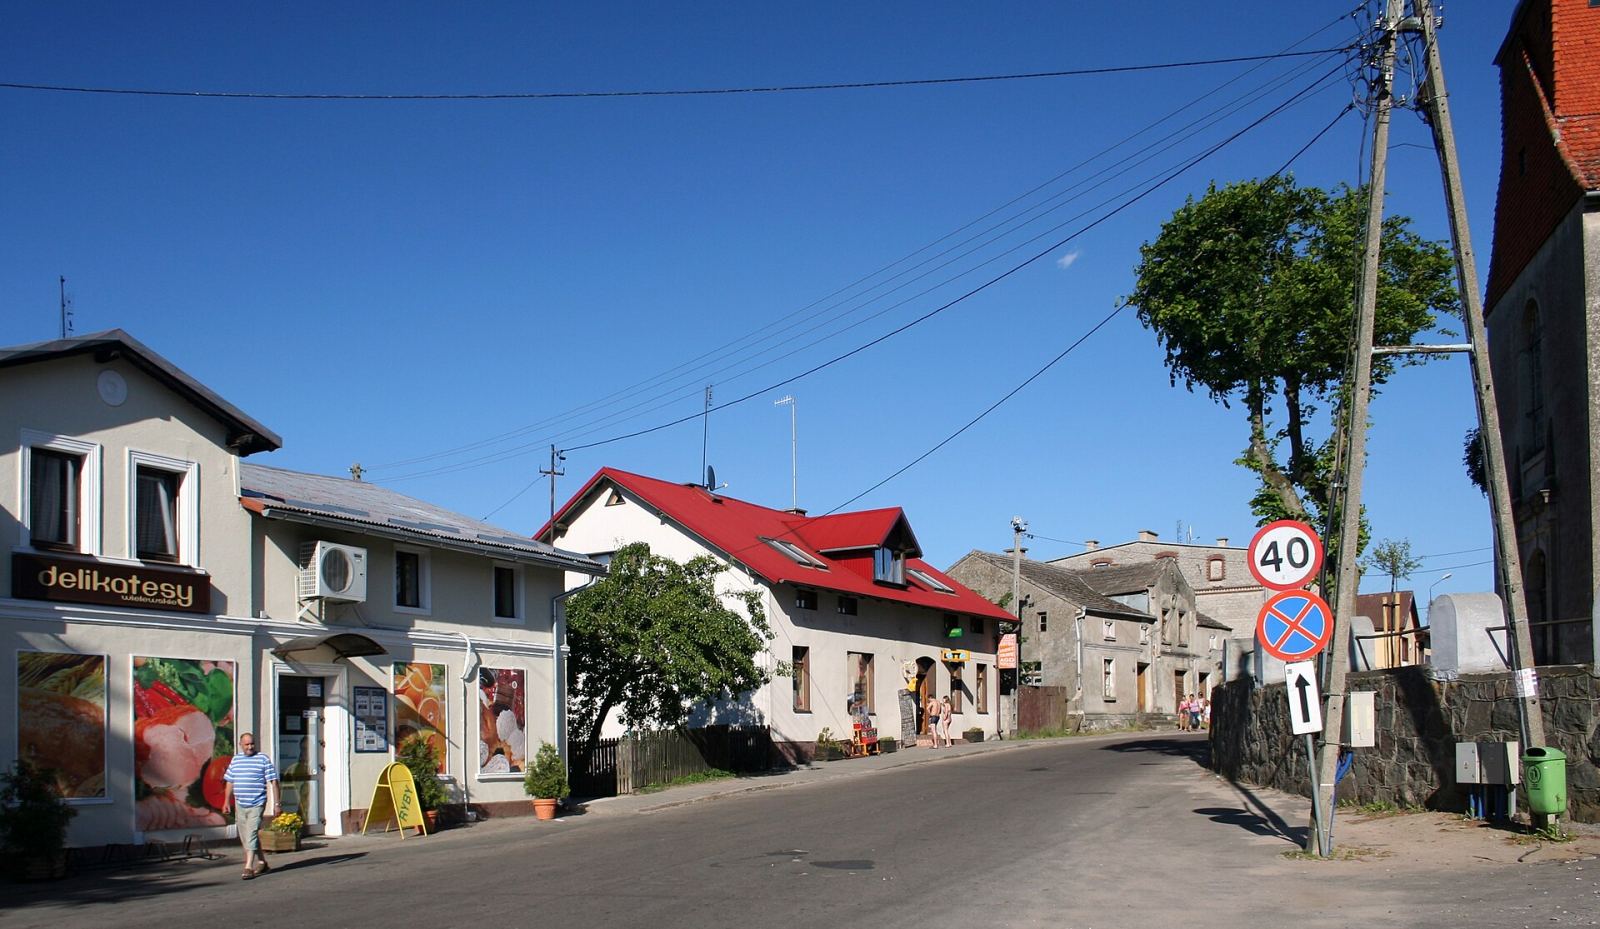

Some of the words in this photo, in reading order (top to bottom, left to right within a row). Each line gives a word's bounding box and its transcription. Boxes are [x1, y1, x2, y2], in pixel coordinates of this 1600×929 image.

[1260, 537, 1309, 572] 40
[38, 565, 193, 607] delikatesy
[399, 784, 413, 822] RYBY
